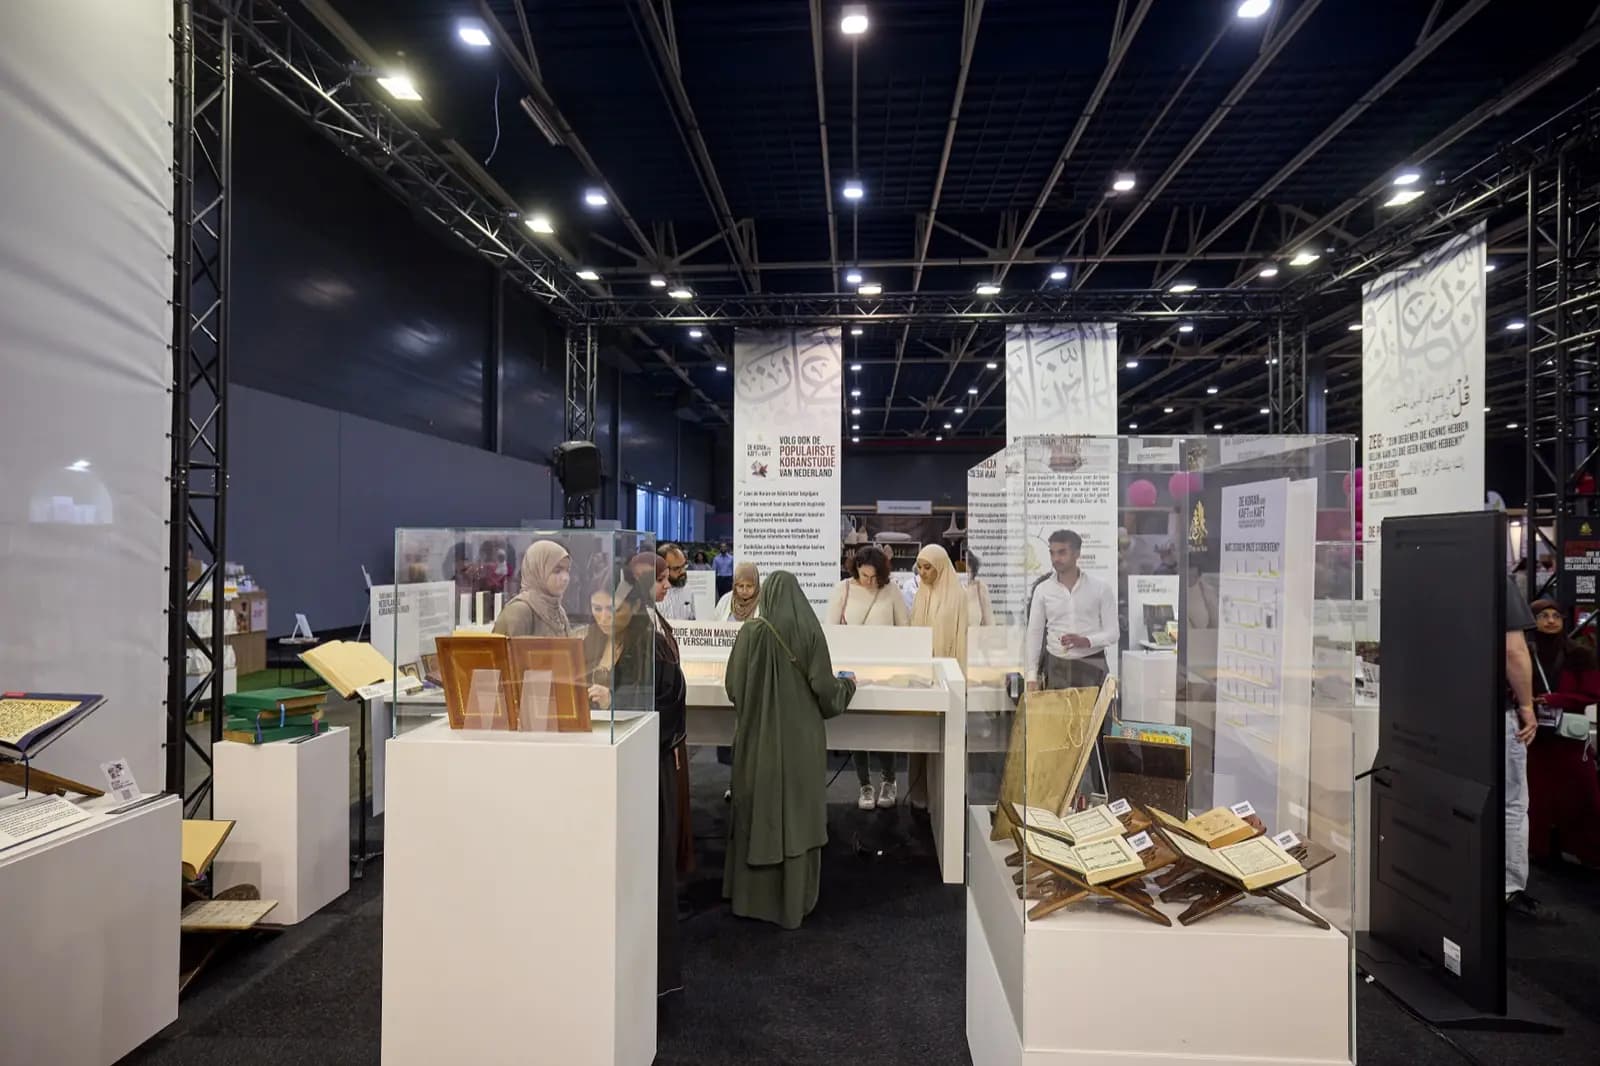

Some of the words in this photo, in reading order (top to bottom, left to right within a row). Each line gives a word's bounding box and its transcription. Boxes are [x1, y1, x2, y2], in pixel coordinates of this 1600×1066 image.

[1428, 425, 1446, 438] KENNIS
[1447, 421, 1469, 434] HEBBEN
[779, 435, 796, 445] VOLG
[797, 435, 811, 445] OOK
[812, 435, 821, 445] DE
[779, 445, 835, 456] POPULAIRSTE
[1420, 440, 1437, 453] KENNIS
[779, 457, 835, 467] KORANSTUDIE
[779, 468, 793, 478] VAN
[794, 468, 833, 478] NEDERLAND
[690, 628, 712, 637] KORAN
